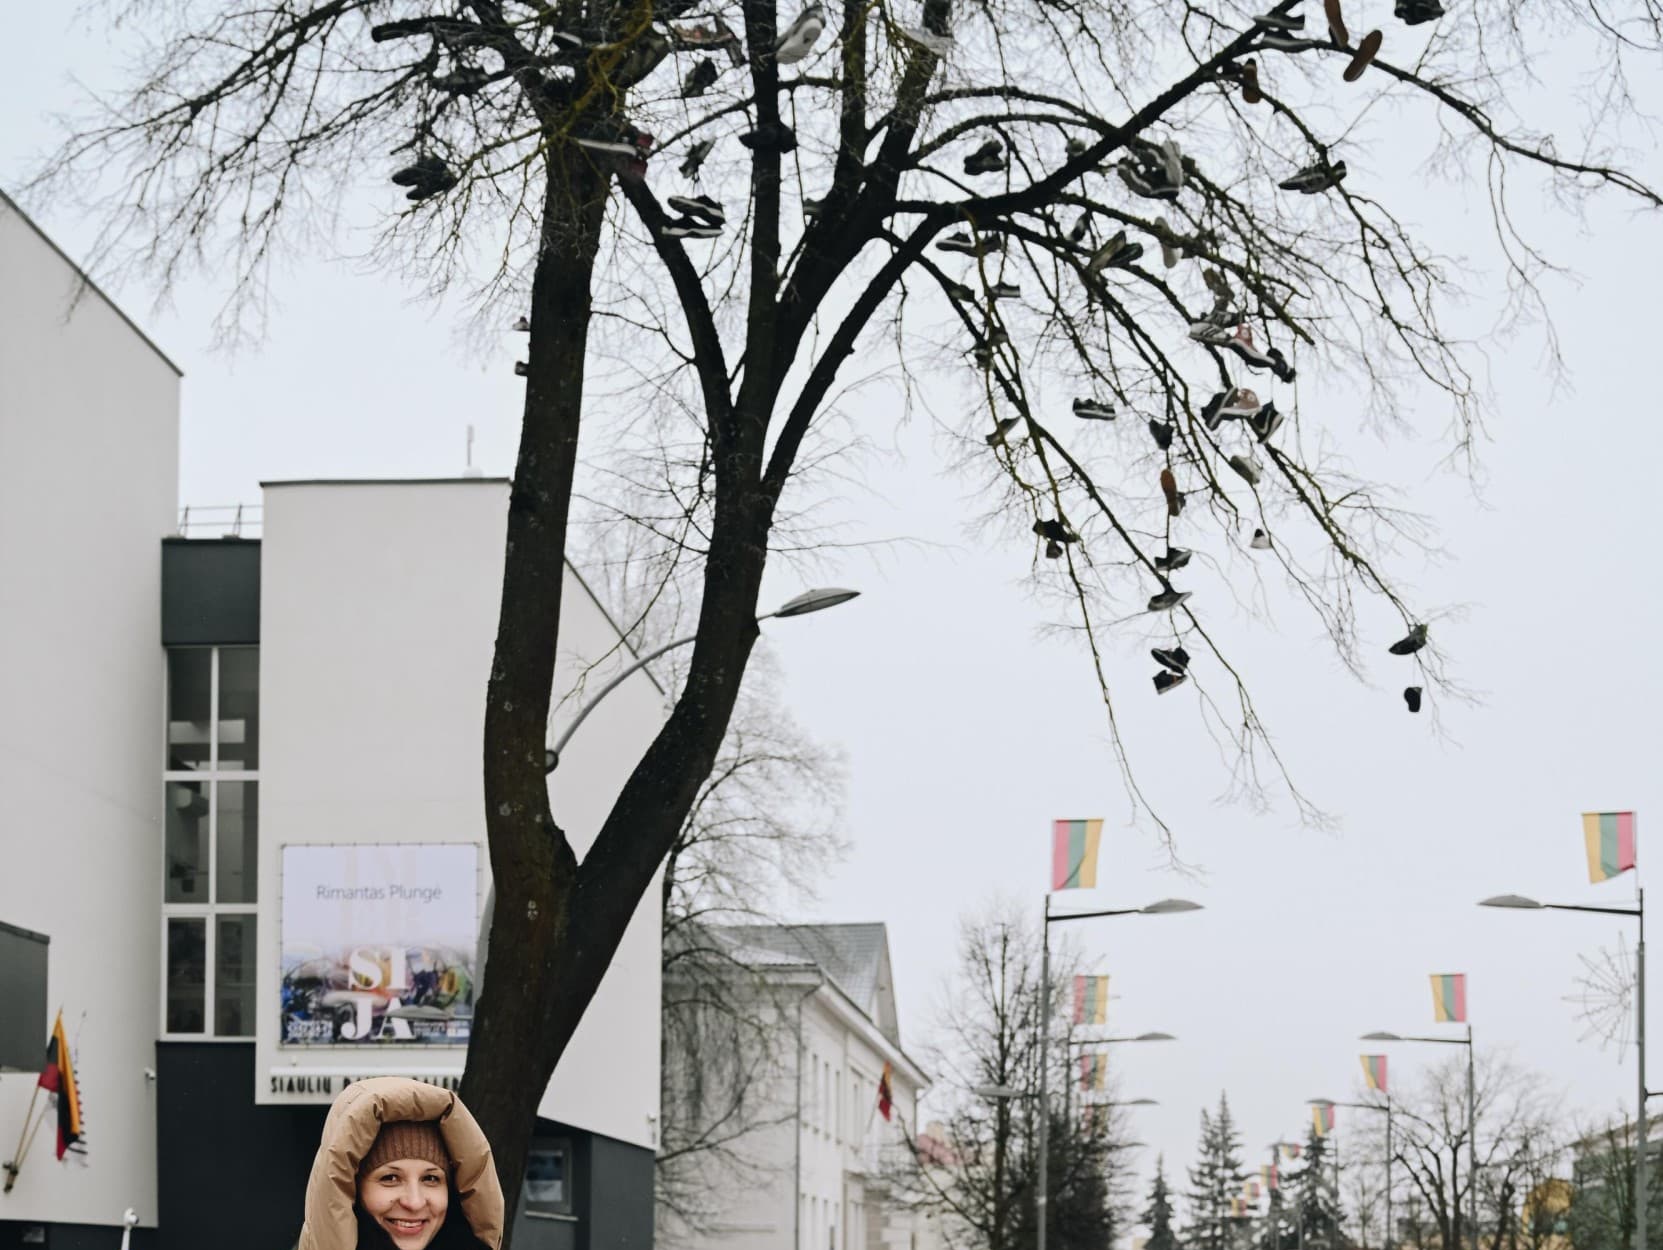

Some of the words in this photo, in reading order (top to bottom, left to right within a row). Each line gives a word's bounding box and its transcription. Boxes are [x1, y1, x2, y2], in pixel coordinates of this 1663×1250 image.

[316, 884, 385, 900] Rimantas
[349, 948, 408, 990] SI
[341, 997, 416, 1040] JA
